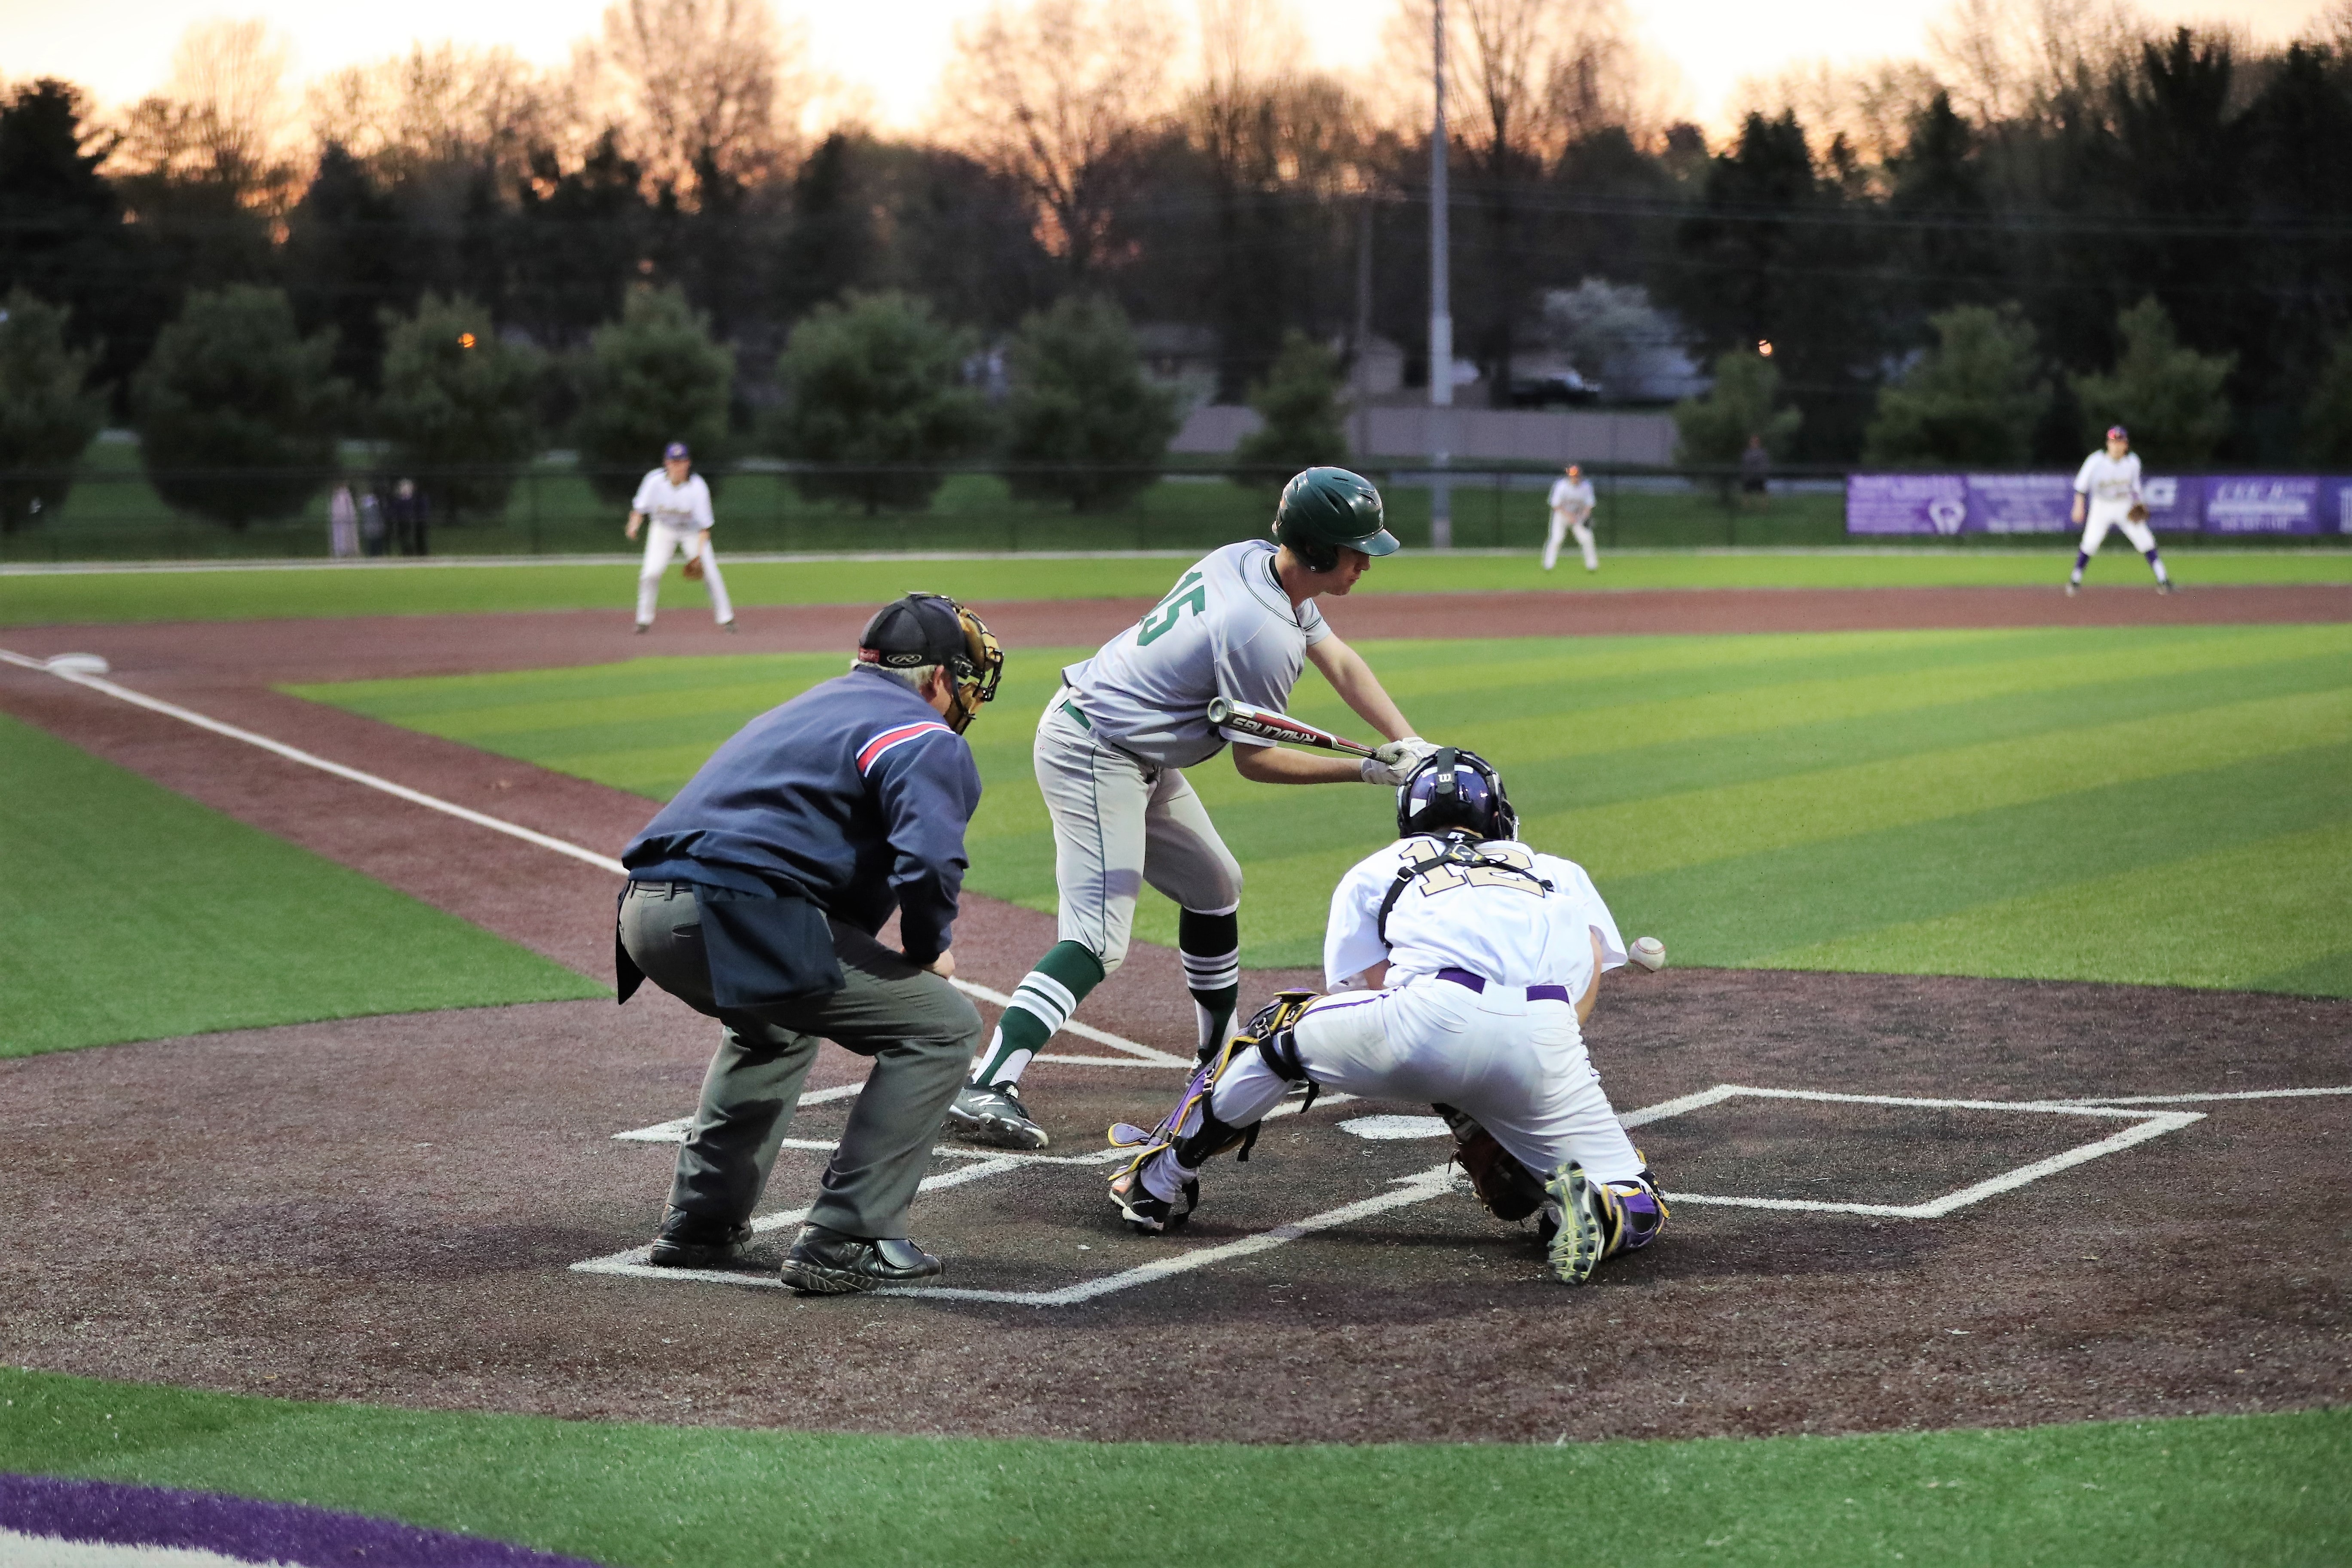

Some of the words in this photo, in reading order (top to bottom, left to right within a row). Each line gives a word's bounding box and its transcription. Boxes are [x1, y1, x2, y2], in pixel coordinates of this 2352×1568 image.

[1137, 571, 1205, 646] 15
[1232, 717, 1317, 743] RAWLINGS
[1399, 840, 1545, 898] 12
